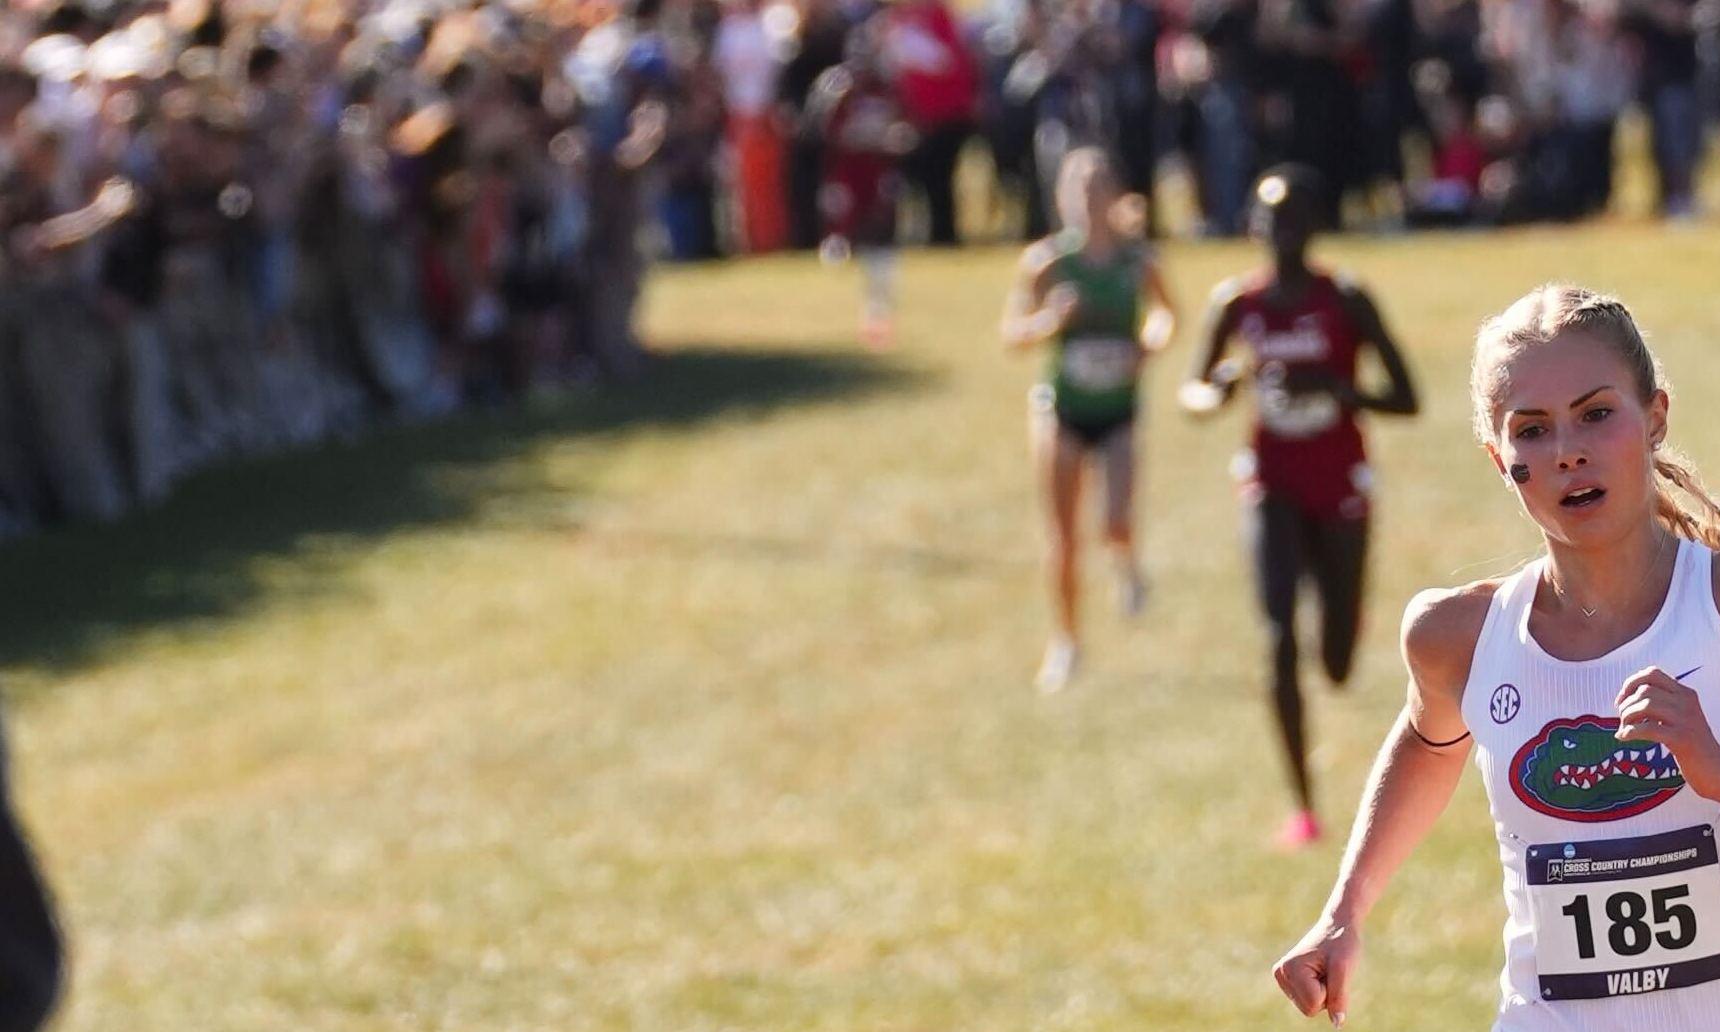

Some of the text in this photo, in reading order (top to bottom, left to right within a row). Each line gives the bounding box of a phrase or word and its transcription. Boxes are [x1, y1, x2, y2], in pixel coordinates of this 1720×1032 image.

[1491, 685, 1519, 723] SEC
[1563, 848, 1697, 873] CROSS COUNTRY CHAMPIONSHIPS
[1562, 884, 1697, 960] 185
[1607, 967, 1670, 996] VALBY
